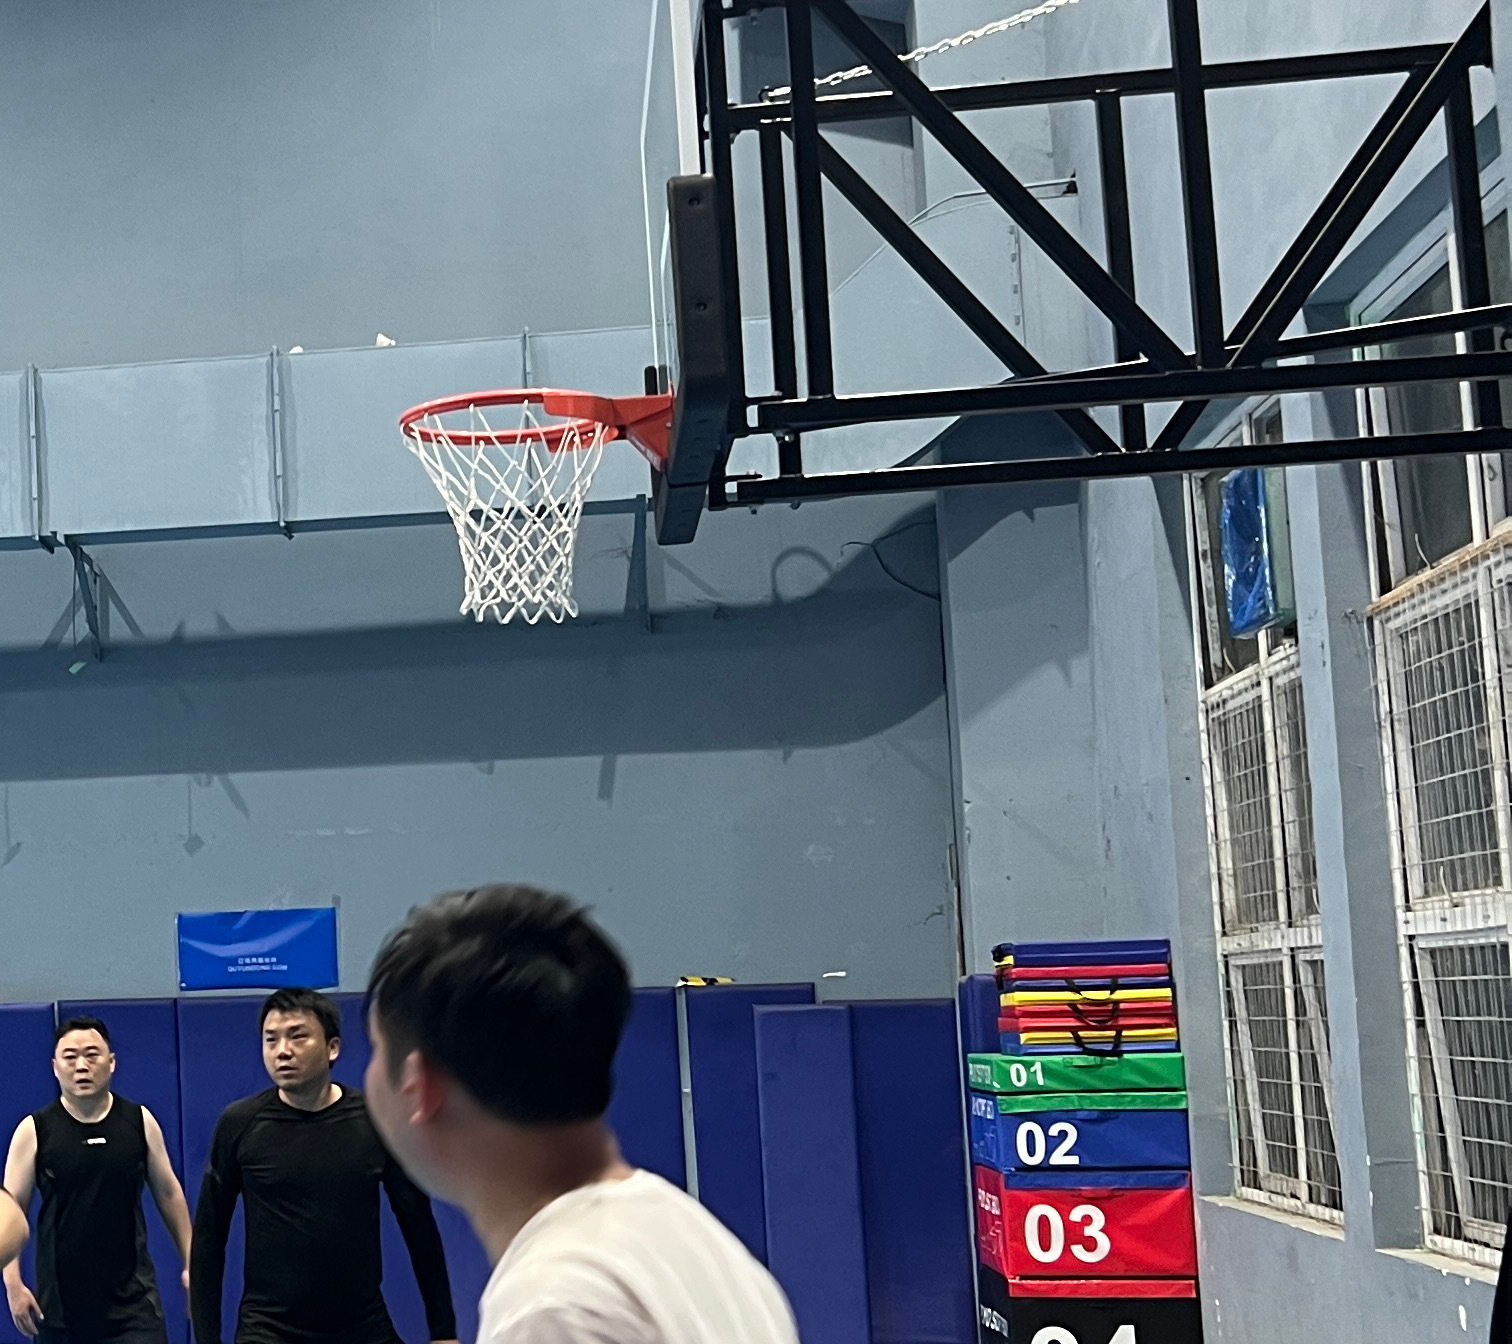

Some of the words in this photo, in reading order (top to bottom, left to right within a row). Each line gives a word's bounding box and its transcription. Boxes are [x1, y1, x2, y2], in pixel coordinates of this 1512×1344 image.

[1010, 1061, 1045, 1087] 01
[1015, 1121, 1080, 1166] 02
[1024, 1203, 1111, 1264] 03
